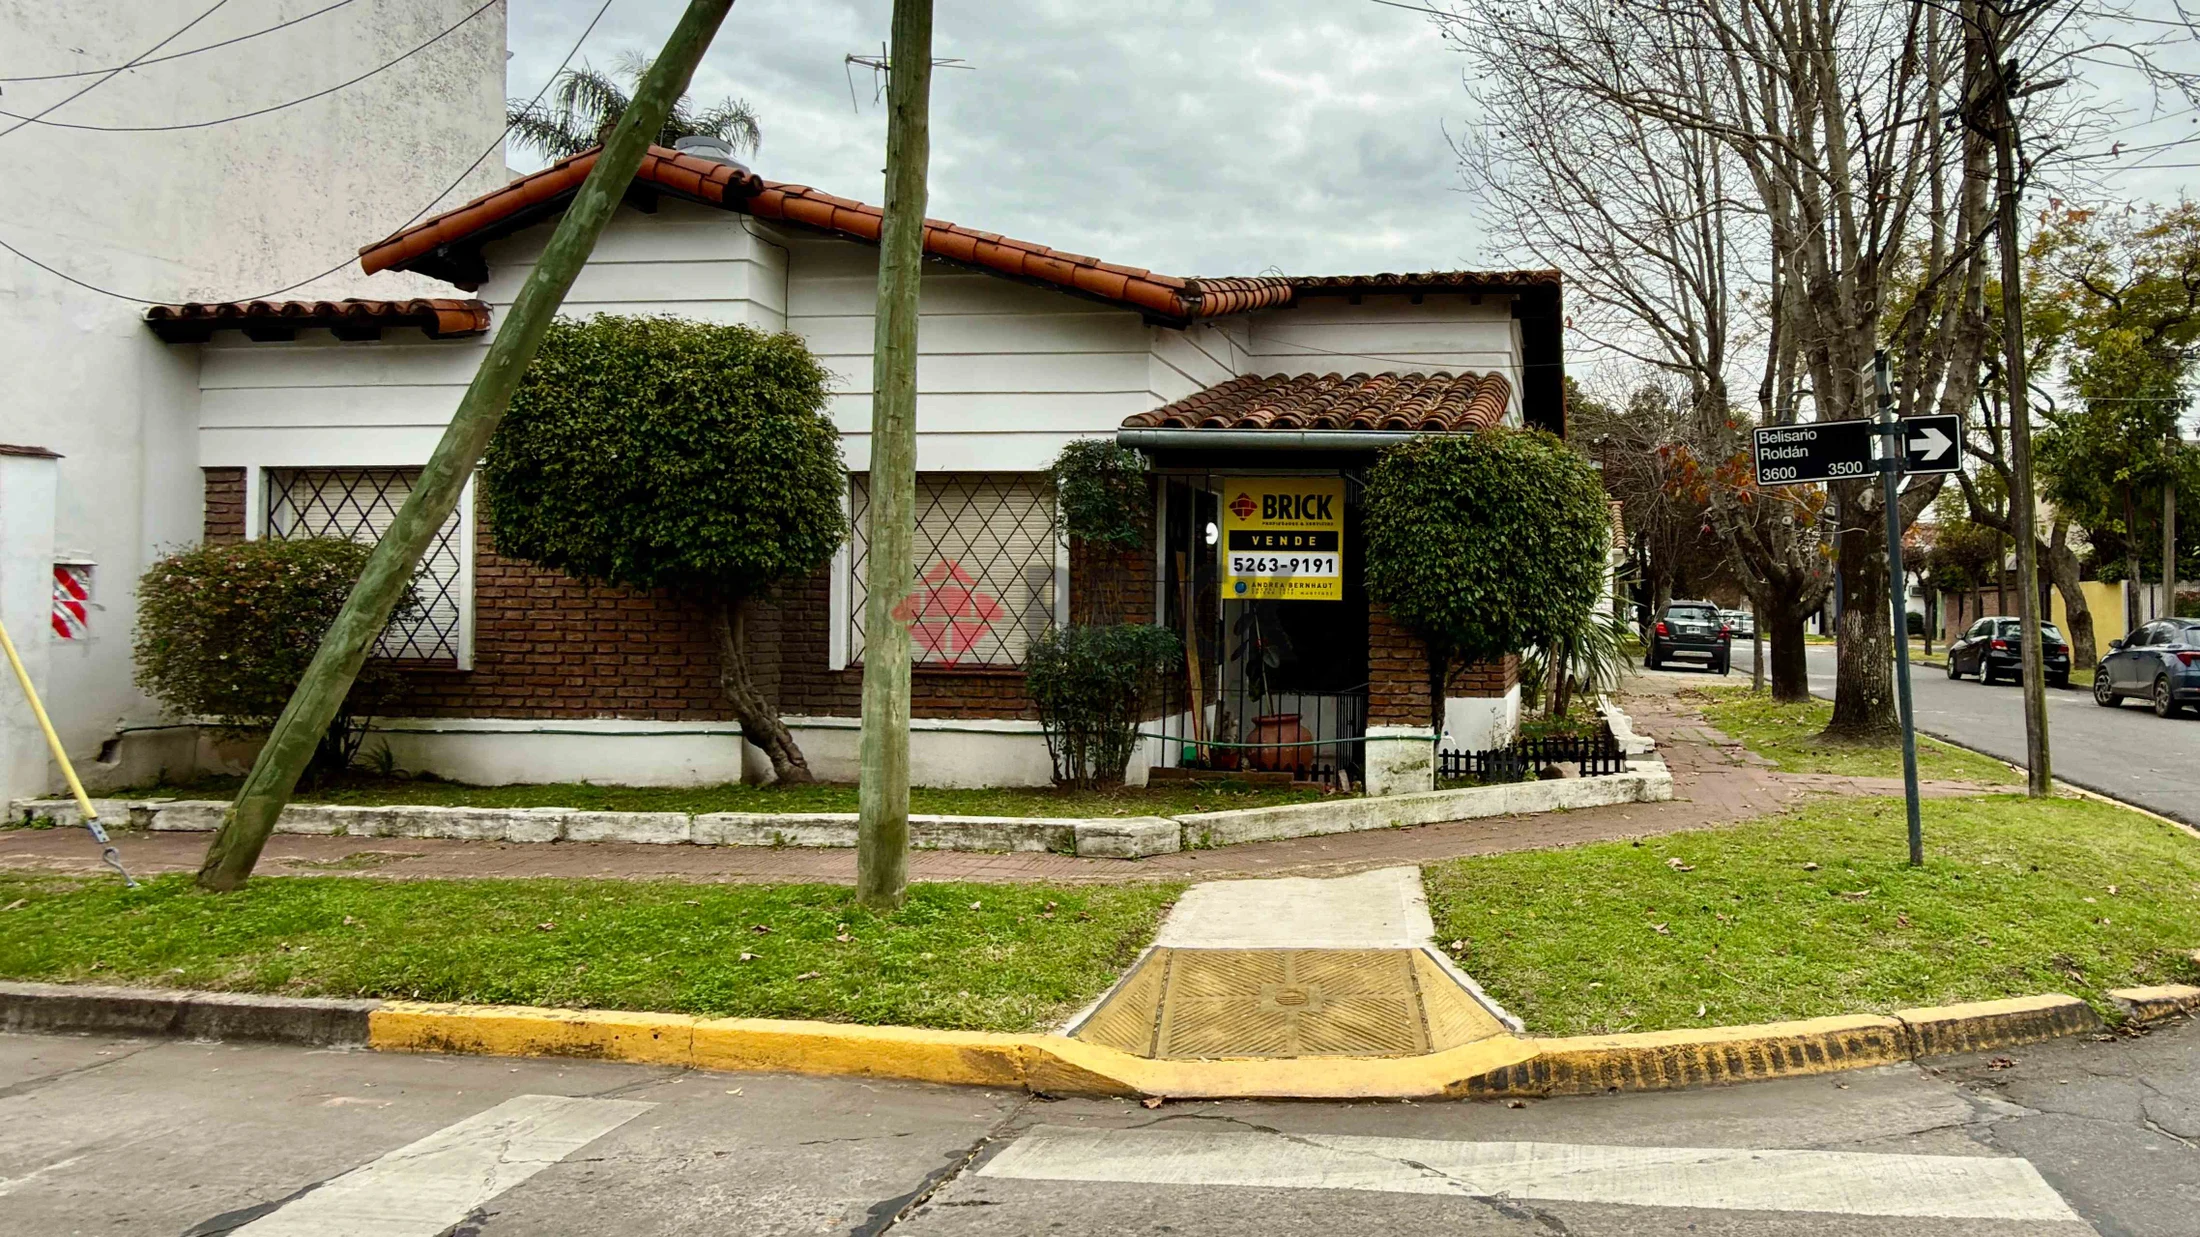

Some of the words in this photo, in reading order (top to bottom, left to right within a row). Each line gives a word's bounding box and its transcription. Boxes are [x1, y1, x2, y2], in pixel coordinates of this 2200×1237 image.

[1759, 429, 1817, 445] Belisario
[1760, 445, 1809, 461] Roldán
[1762, 466, 1797, 481] 3600
[1828, 461, 1863, 476] 3500
[1262, 494, 1334, 520] BRICK
[1252, 535, 1317, 546] VENDE
[1233, 558, 1334, 573] 5263-9191
